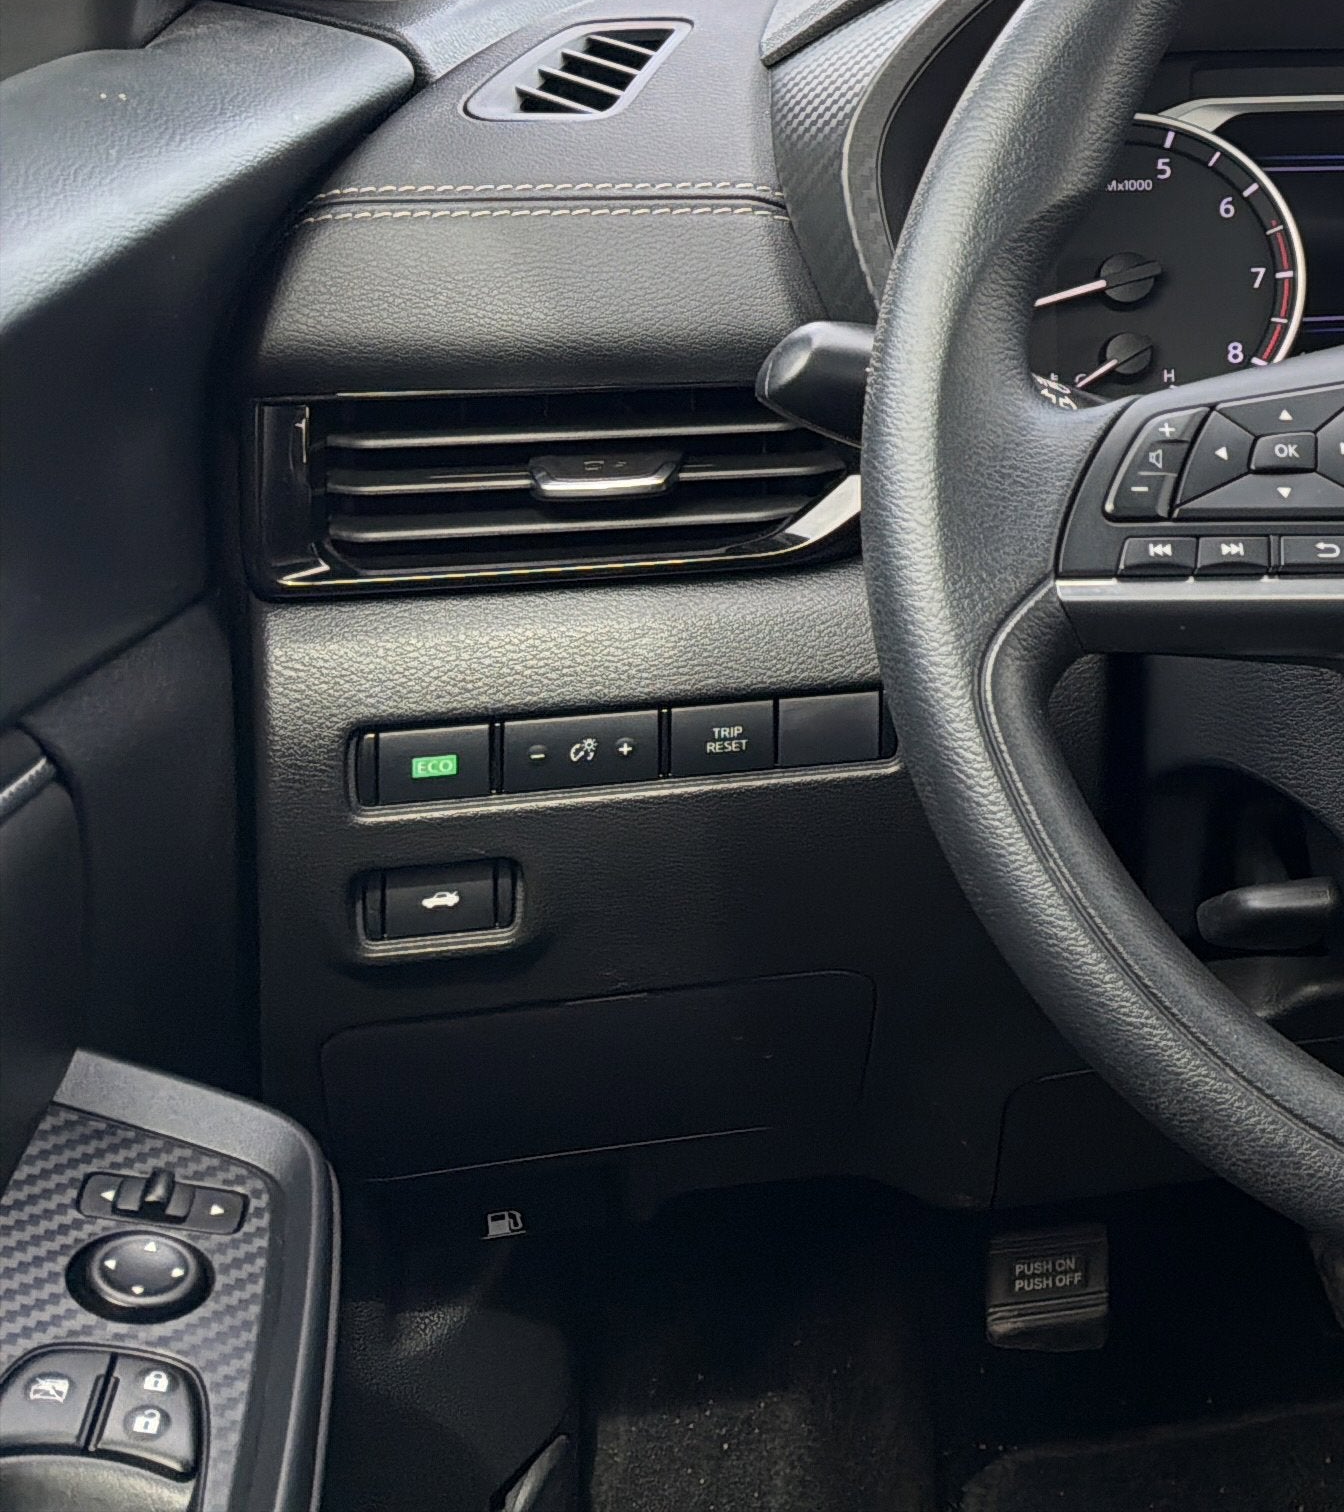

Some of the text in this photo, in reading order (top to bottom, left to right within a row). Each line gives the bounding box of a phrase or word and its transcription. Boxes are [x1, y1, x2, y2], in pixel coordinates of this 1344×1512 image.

[1156, 158, 1171, 179] 5
[1219, 196, 1235, 218] 6
[1250, 267, 1266, 289] 7
[1226, 341, 1243, 364] 8
[1163, 368, 1176, 383] H
[1274, 443, 1300, 459] OK
[712, 725, 743, 740] TRIP
[706, 738, 749, 754] RESET
[416, 758, 454, 776] ECO
[1015, 1256, 1076, 1276] PUSH ON
[1014, 1271, 1082, 1292] PUSH OFF
